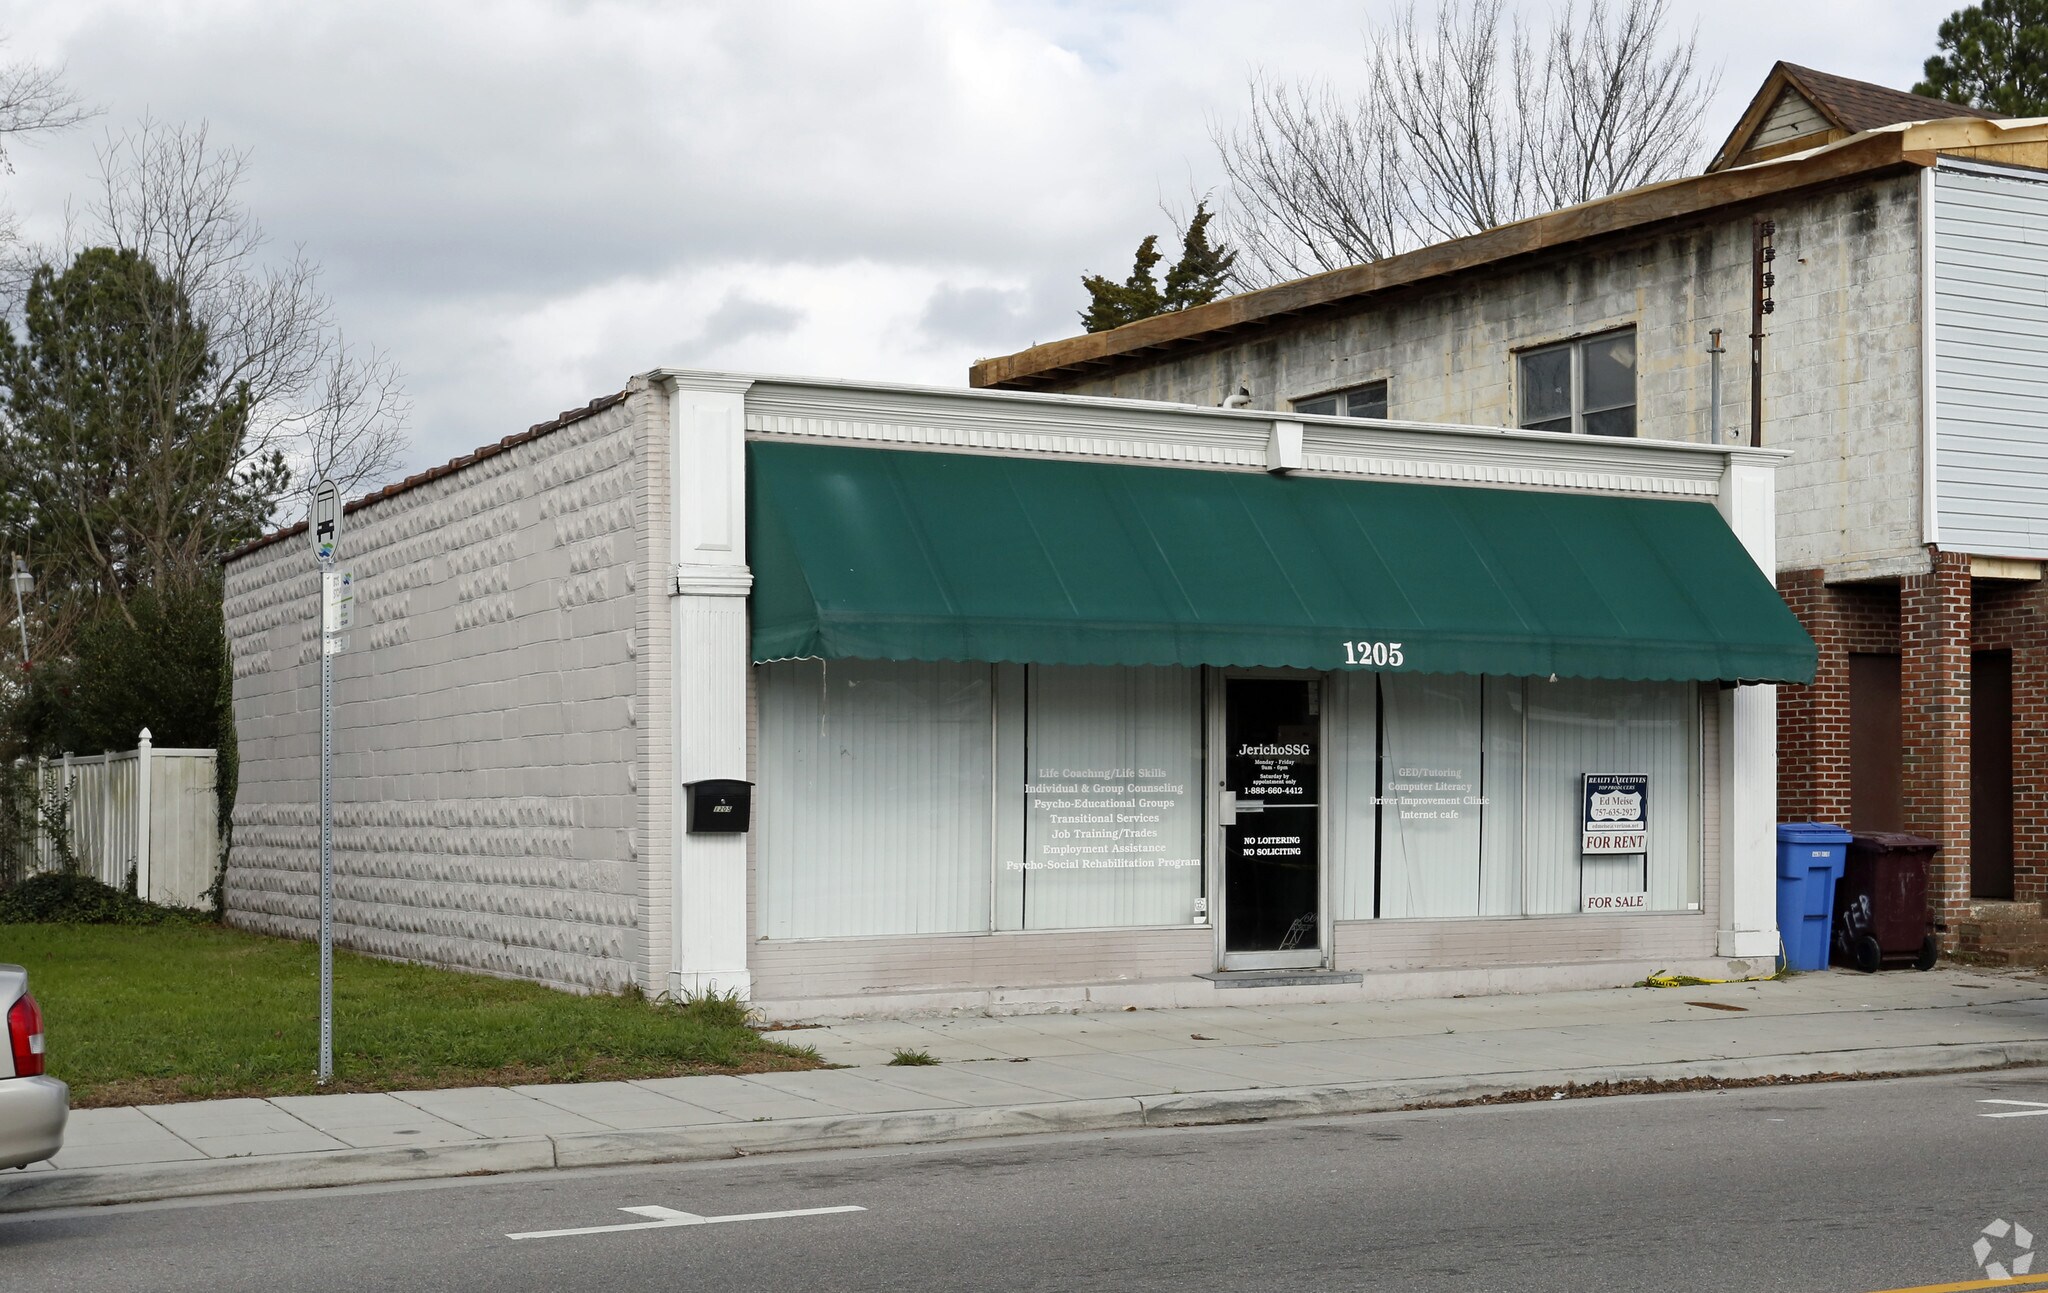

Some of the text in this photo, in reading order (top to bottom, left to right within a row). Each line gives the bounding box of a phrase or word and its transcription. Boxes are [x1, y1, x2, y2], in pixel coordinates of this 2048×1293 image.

[1343, 641, 1404, 667] 1205
[1239, 744, 1310, 756] JerichoSSG
[1039, 768, 1167, 780] Life Coaching/Life Skills
[1398, 768, 1462, 779] GED/Tutoring
[1611, 776, 1647, 785] EXECUTIVES
[1025, 783, 1184, 795] Individual & Group Counseling
[1388, 782, 1472, 793] Computer Literacy
[1034, 799, 1175, 811] Psycho-Educational Groups
[1370, 796, 1490, 807] Driver Improvement Clinic
[1599, 796, 1634, 805] Ed Meise
[1400, 810, 1459, 819] Internet cafe
[1594, 808, 1637, 816] 757-635-2927
[1050, 813, 1160, 824] Transitional Services
[1052, 828, 1157, 840] Job Training/Trades
[1243, 836, 1301, 845] NO LOITERING
[1586, 835, 1645, 849] FOR RENT
[1043, 844, 1166, 856] Employment Assistance
[1243, 848, 1255, 856] NO
[1006, 858, 1201, 872] Psycho-Social Rehabilitation Program
[1588, 896, 1644, 909] FOR SALE
